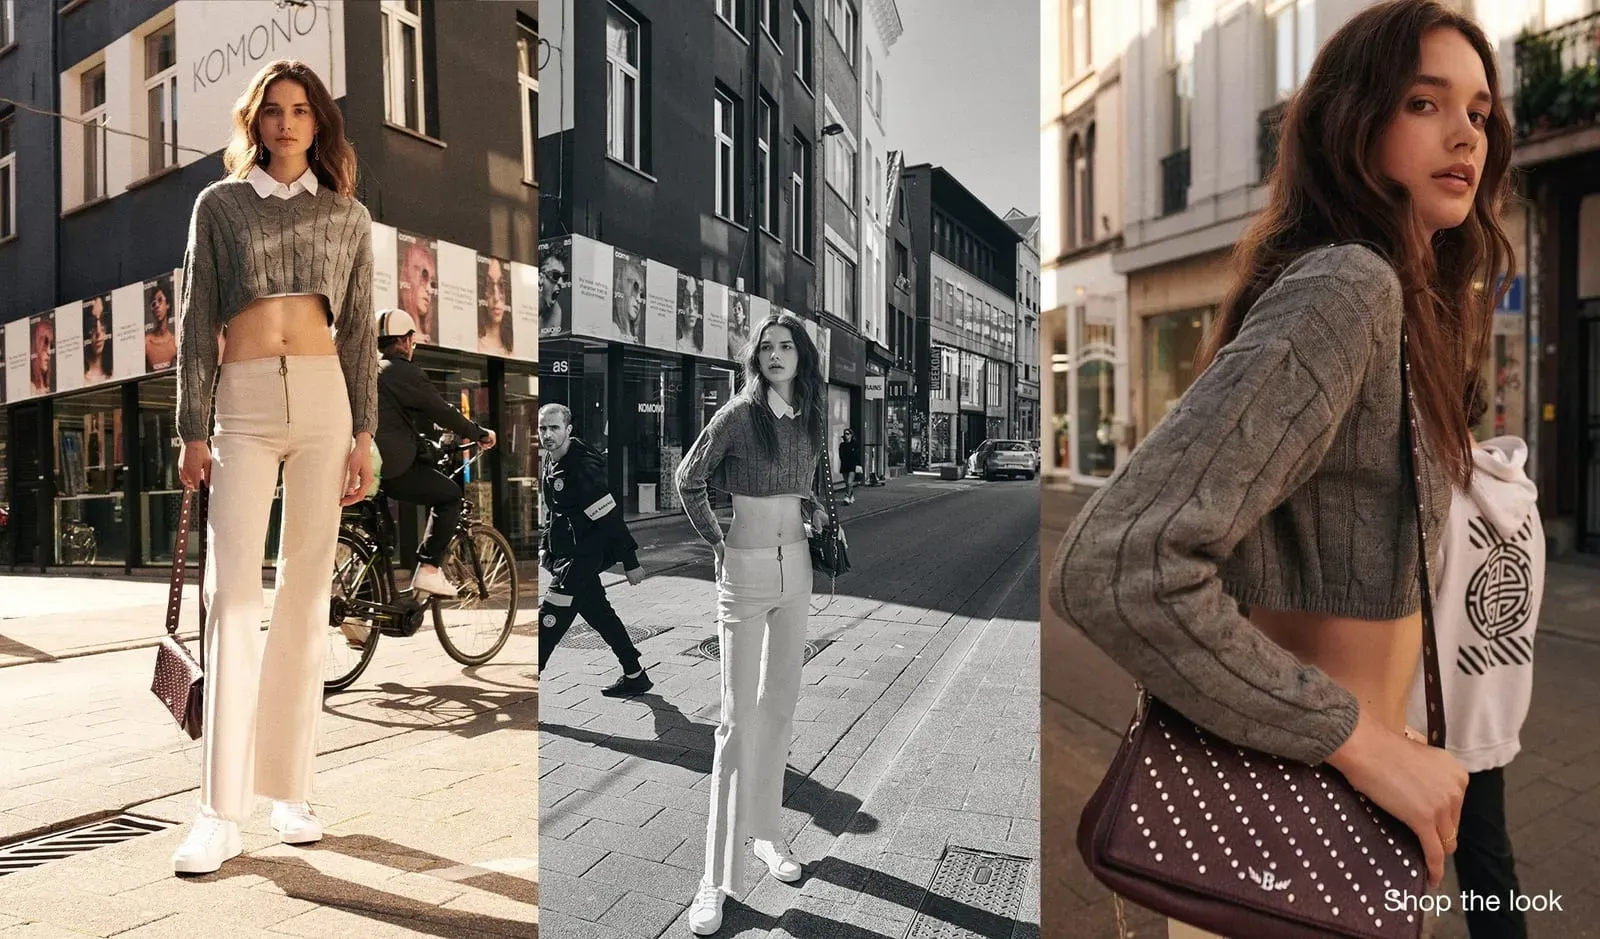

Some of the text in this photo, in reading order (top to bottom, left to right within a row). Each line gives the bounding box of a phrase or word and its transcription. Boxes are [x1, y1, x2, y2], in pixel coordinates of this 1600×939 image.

[192, 0, 317, 93] KOMONO
[552, 360, 570, 373] as
[930, 348, 941, 390] WEEKDAY
